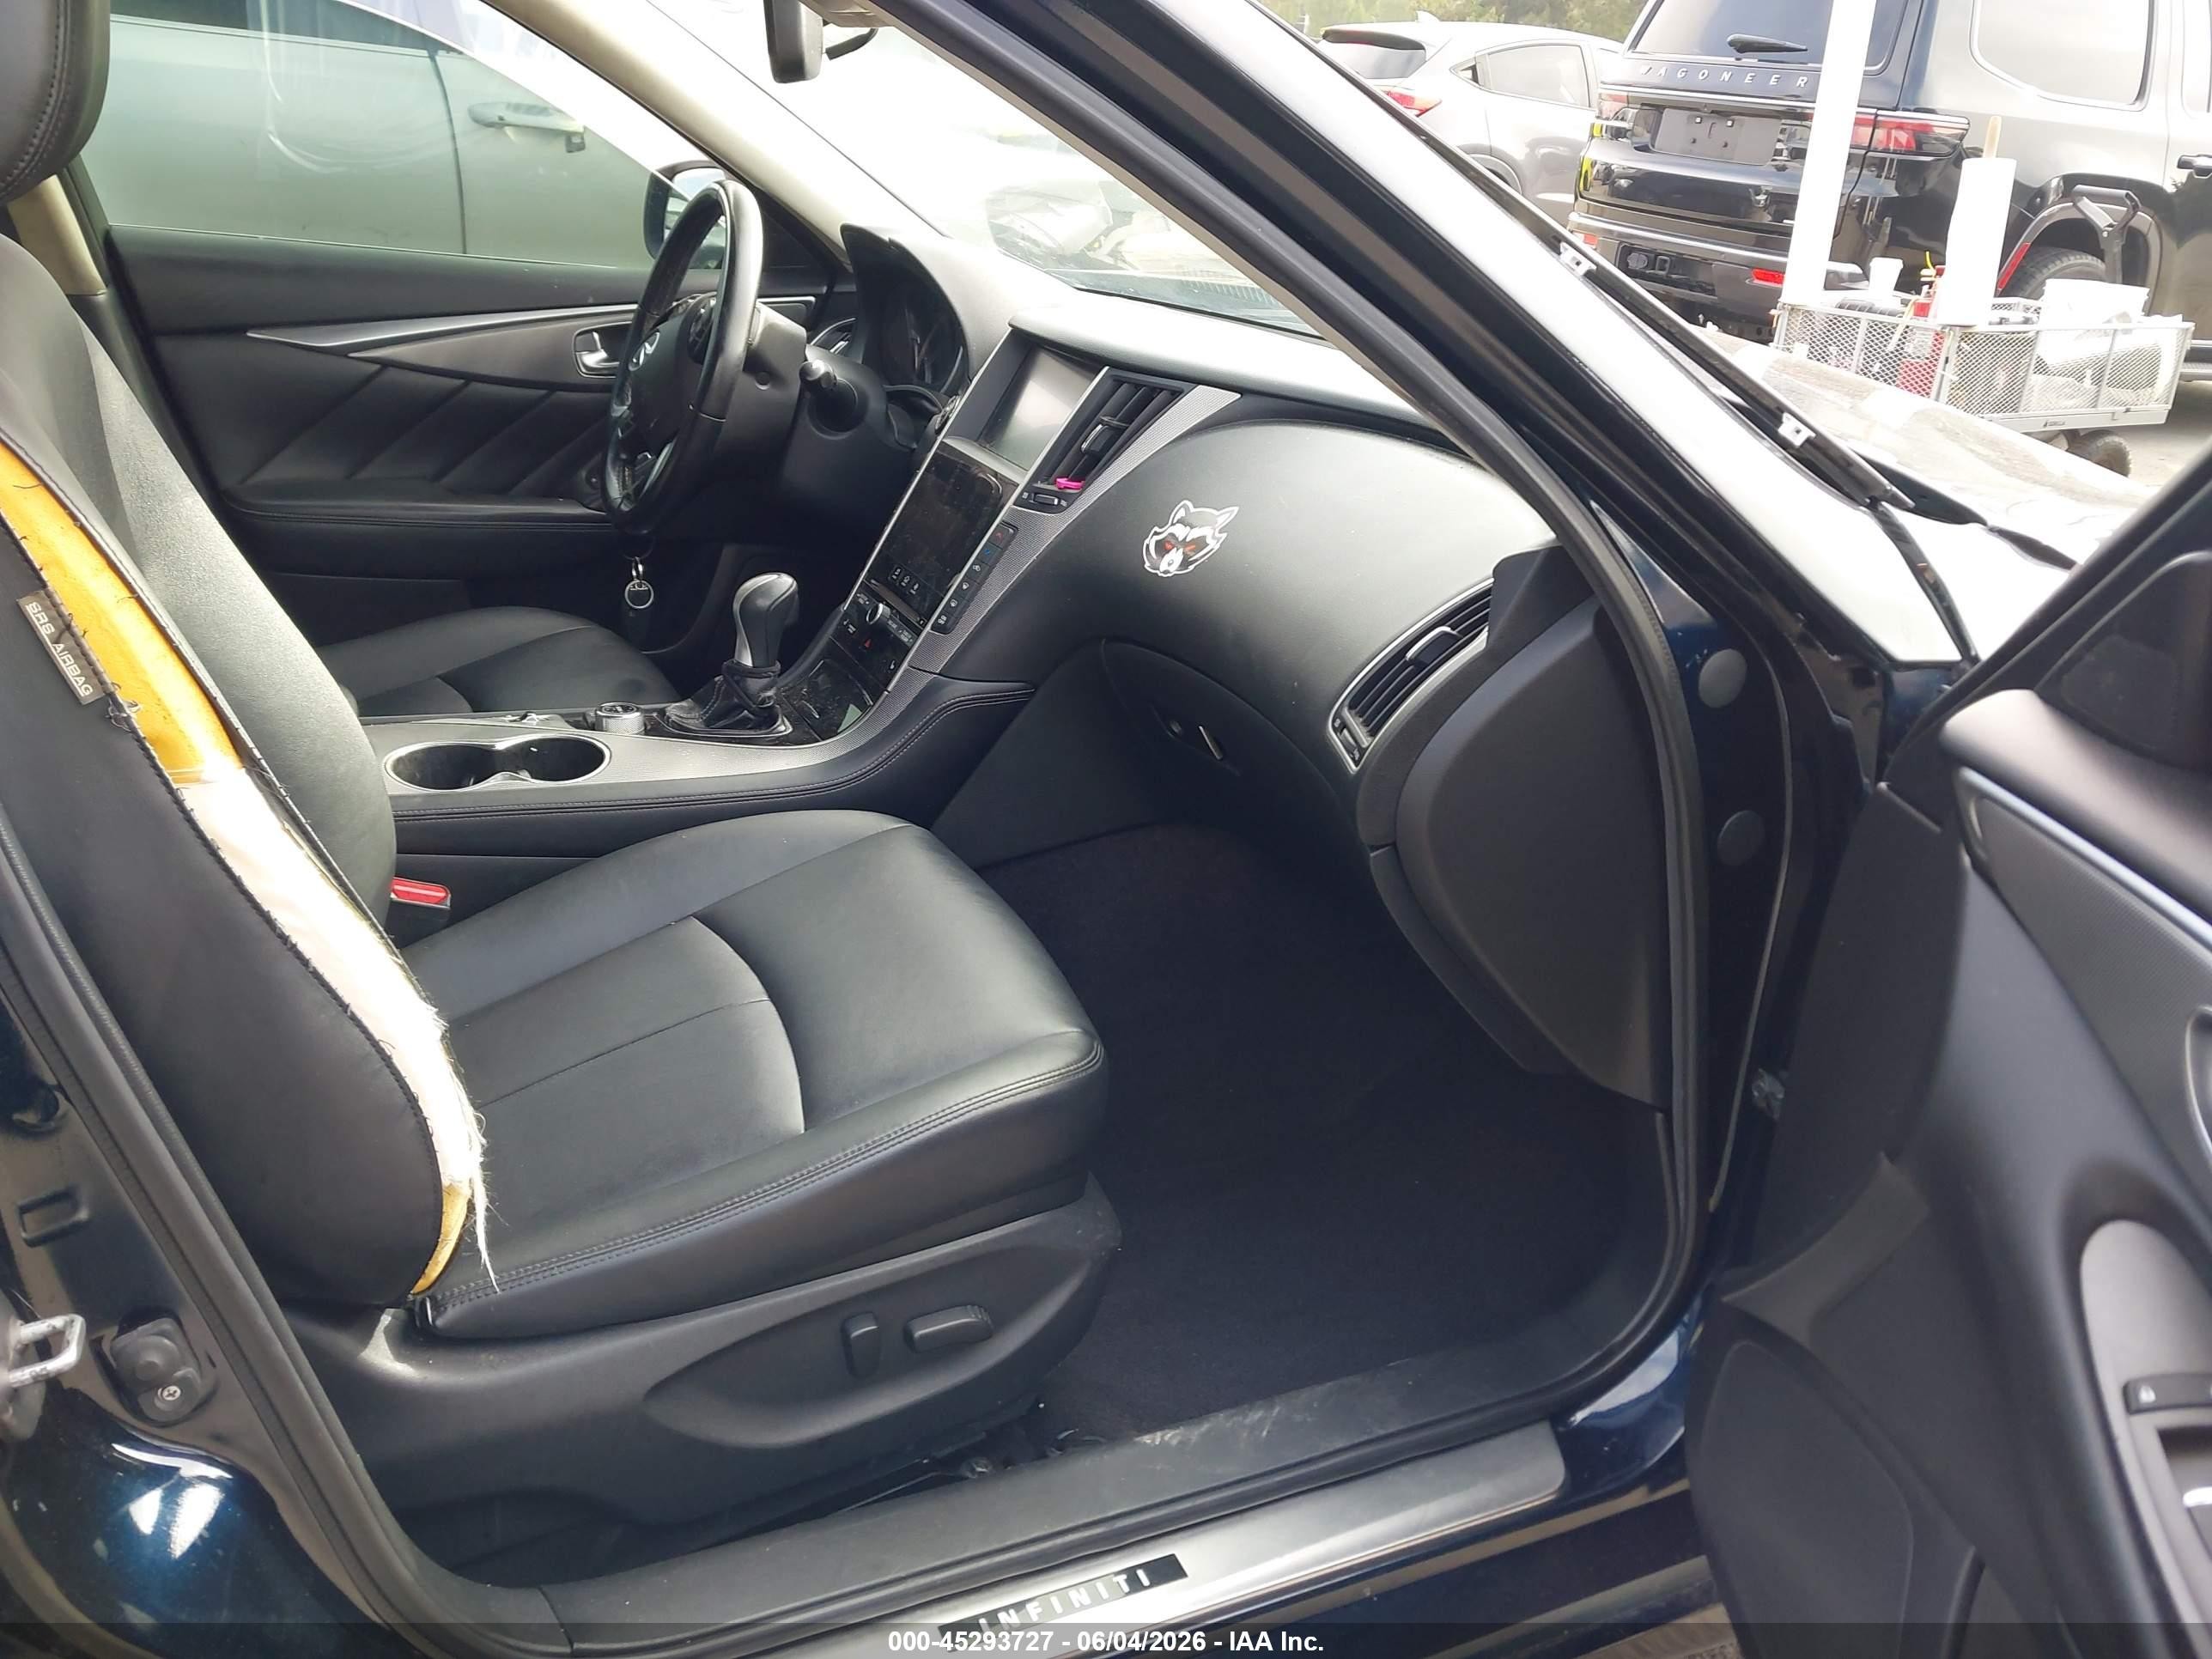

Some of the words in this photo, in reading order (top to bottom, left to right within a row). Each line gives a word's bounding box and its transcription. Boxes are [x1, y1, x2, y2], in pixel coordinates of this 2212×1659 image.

[27, 602, 55, 634] SRS
[52, 643, 93, 696] AIRBAG
[978, 1568, 1151, 1632] INFINITI
